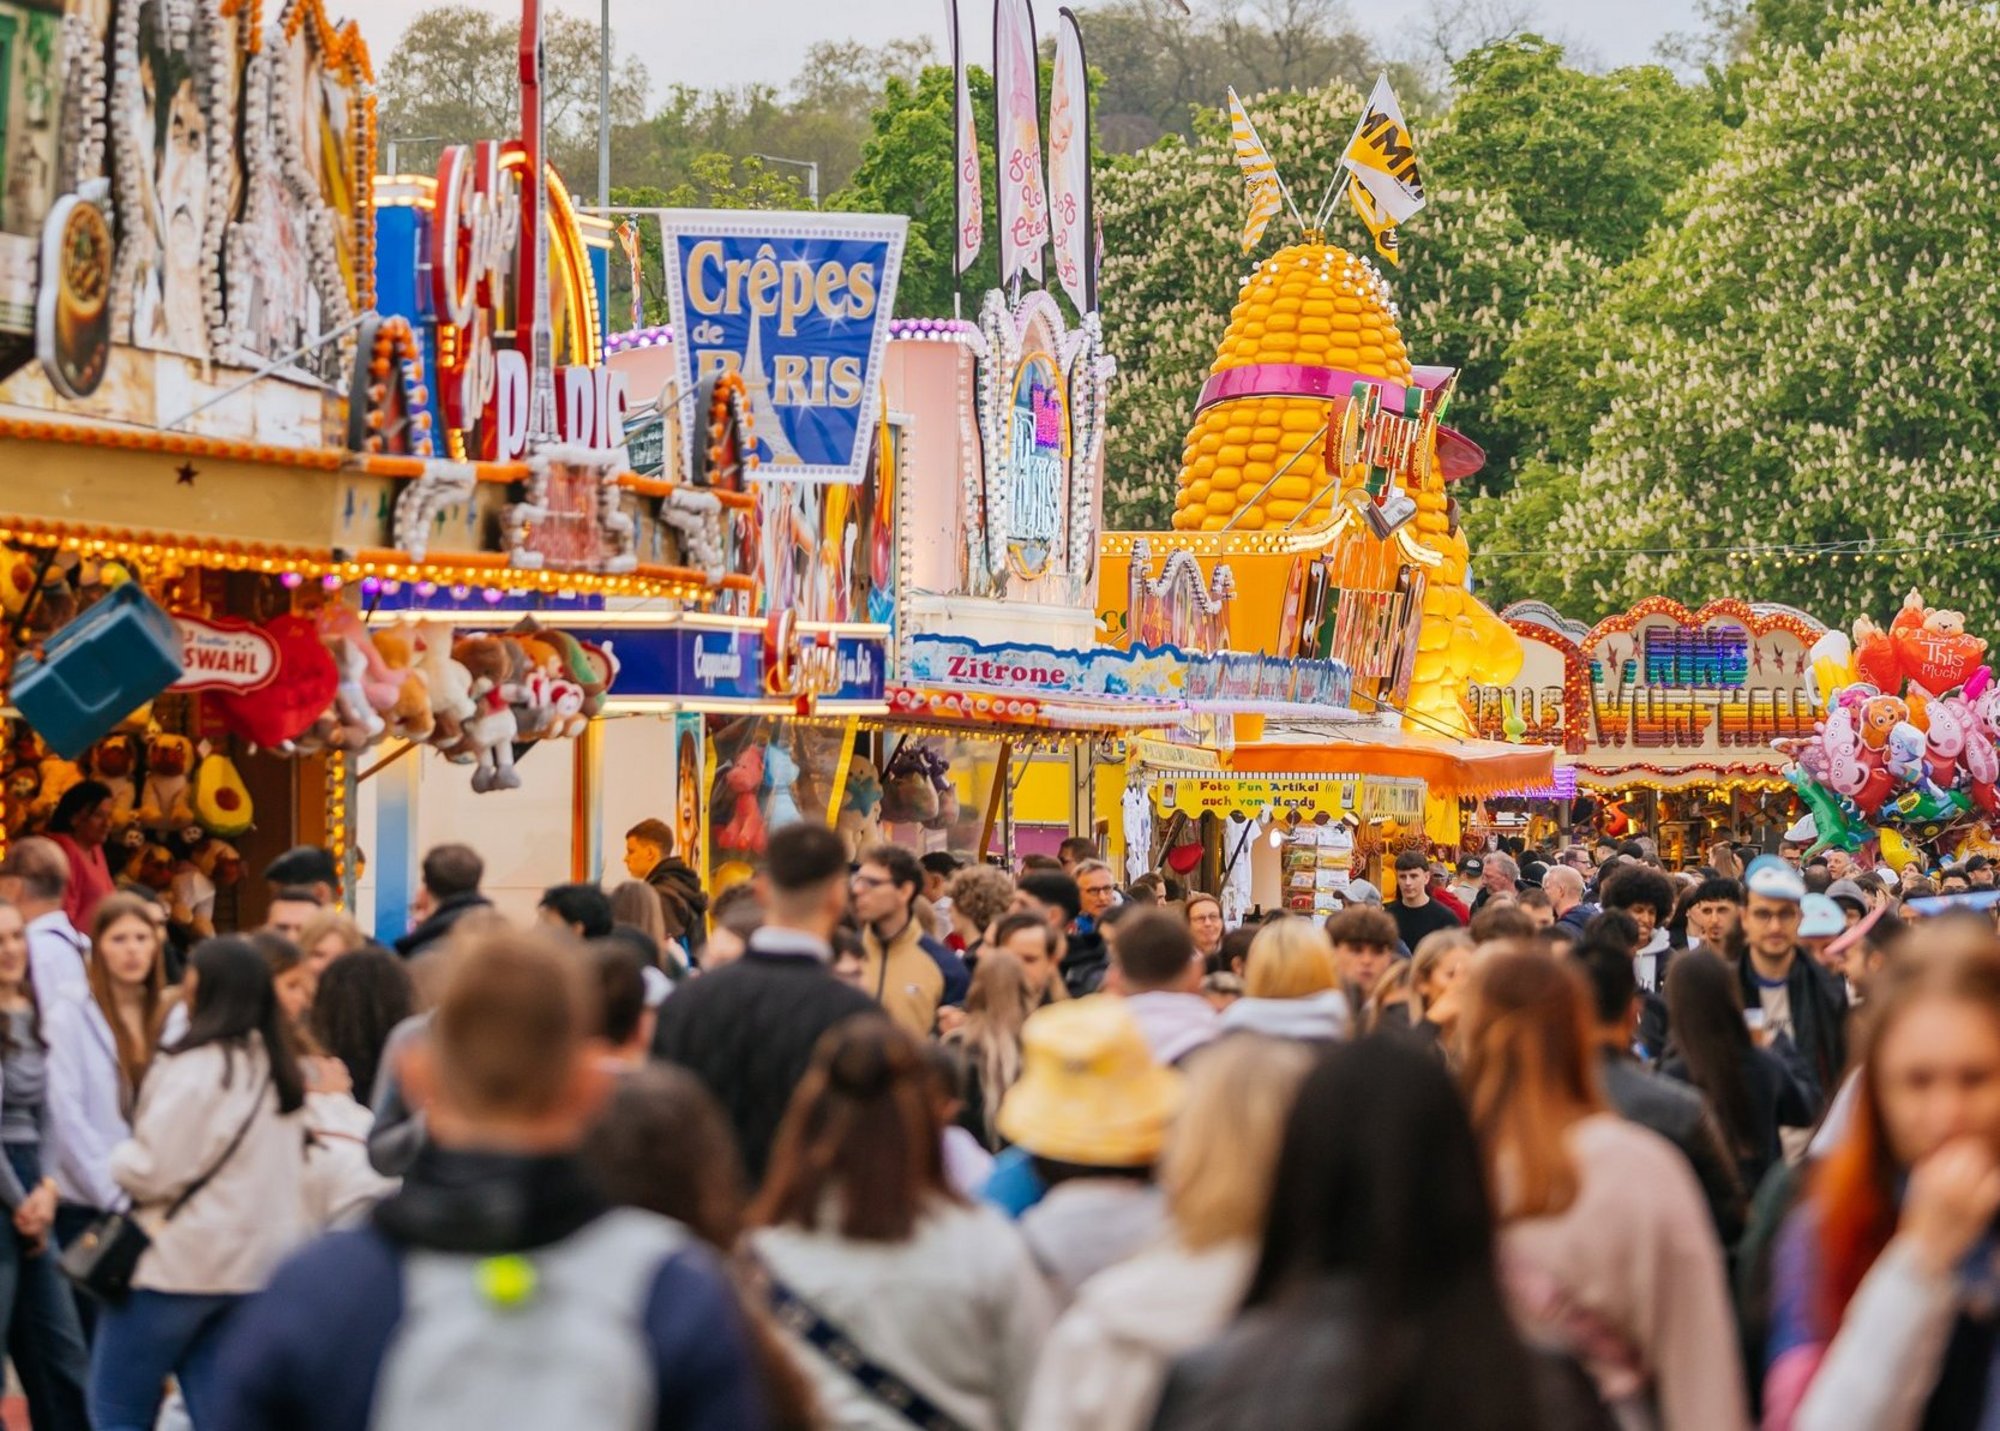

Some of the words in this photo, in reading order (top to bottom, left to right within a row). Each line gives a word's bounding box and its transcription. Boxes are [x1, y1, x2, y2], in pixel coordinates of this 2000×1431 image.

[686, 241, 876, 337] Crêpes
[692, 320, 725, 345] de
[1920, 641, 1965, 667] This
[948, 656, 1065, 684] Zitrone
[1200, 781, 1231, 792] Foto
[1238, 782, 1263, 792] Fun
[1270, 782, 1319, 792] Artikel
[1202, 796, 1232, 806] auch
